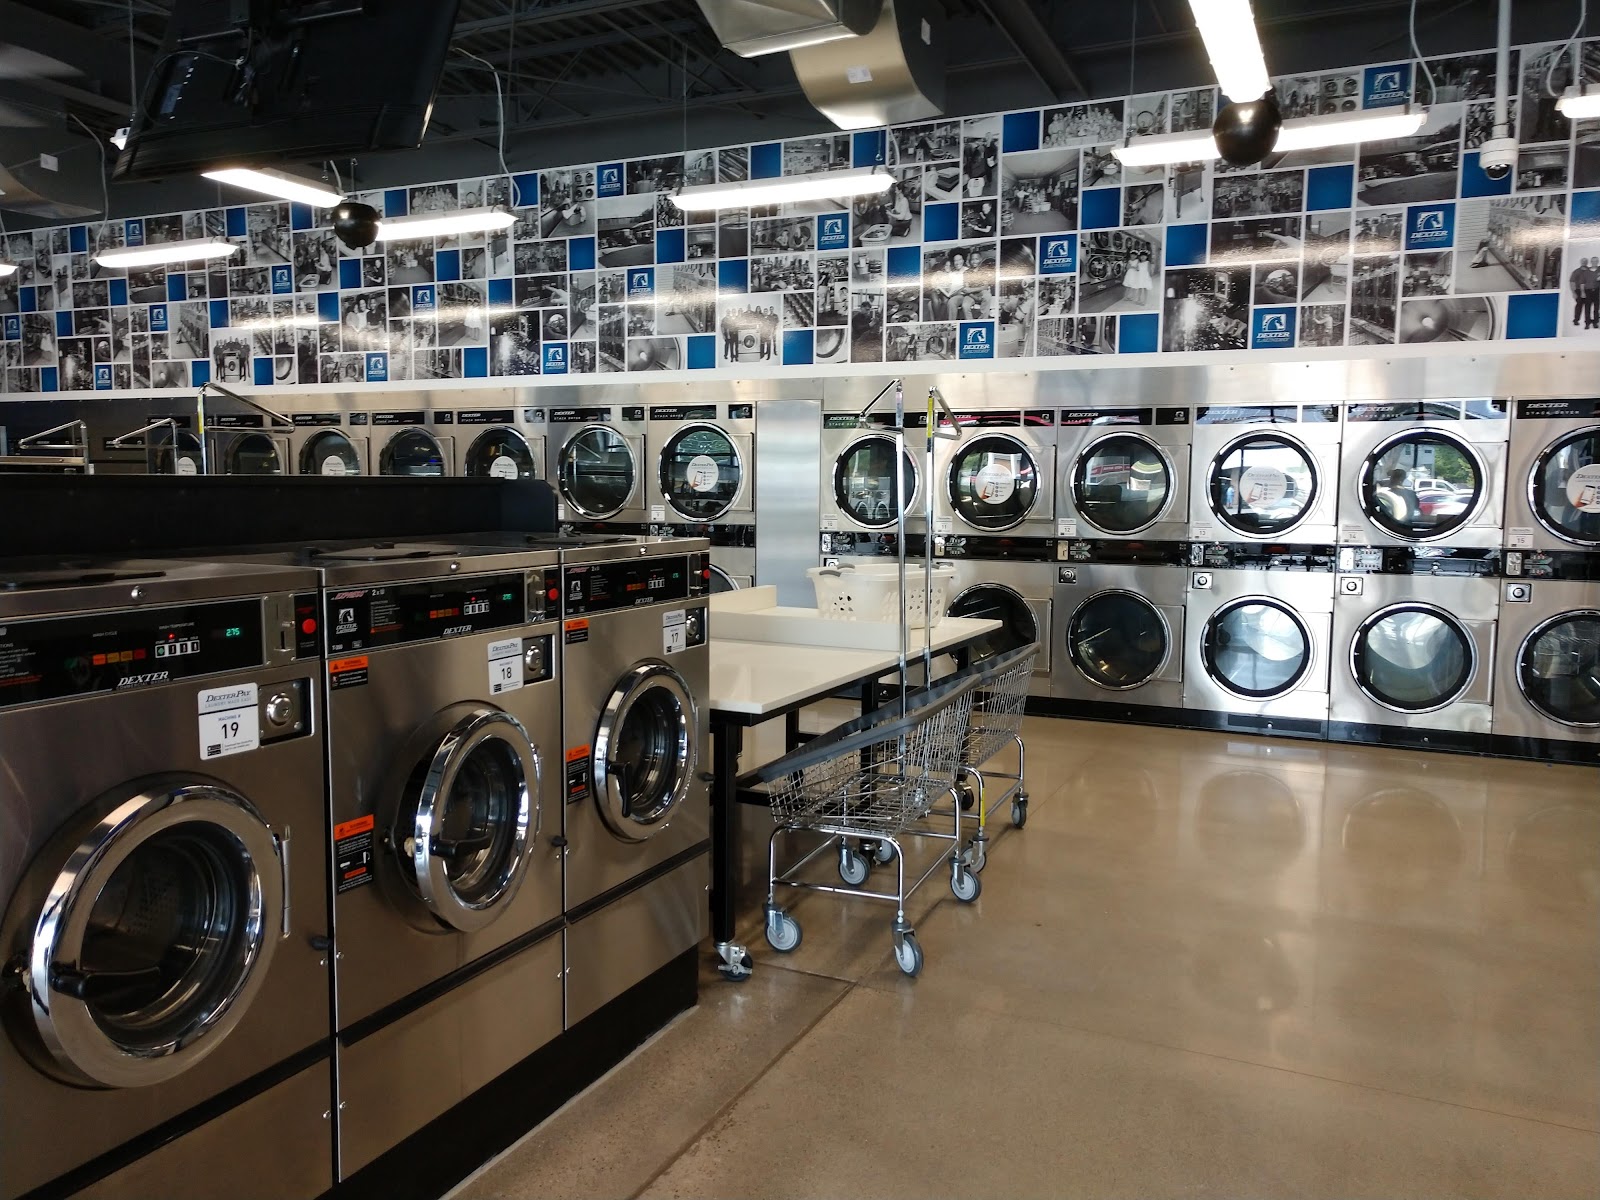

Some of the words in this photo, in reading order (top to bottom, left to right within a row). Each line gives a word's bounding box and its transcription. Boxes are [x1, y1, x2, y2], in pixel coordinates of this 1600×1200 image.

[1368, 91, 1404, 100] DEXTER
[443, 625, 472, 634] DEXTER
[671, 632, 678, 643] 17
[118, 671, 169, 686] DEXTER
[501, 667, 512, 680] 18
[221, 721, 239, 739] 19
